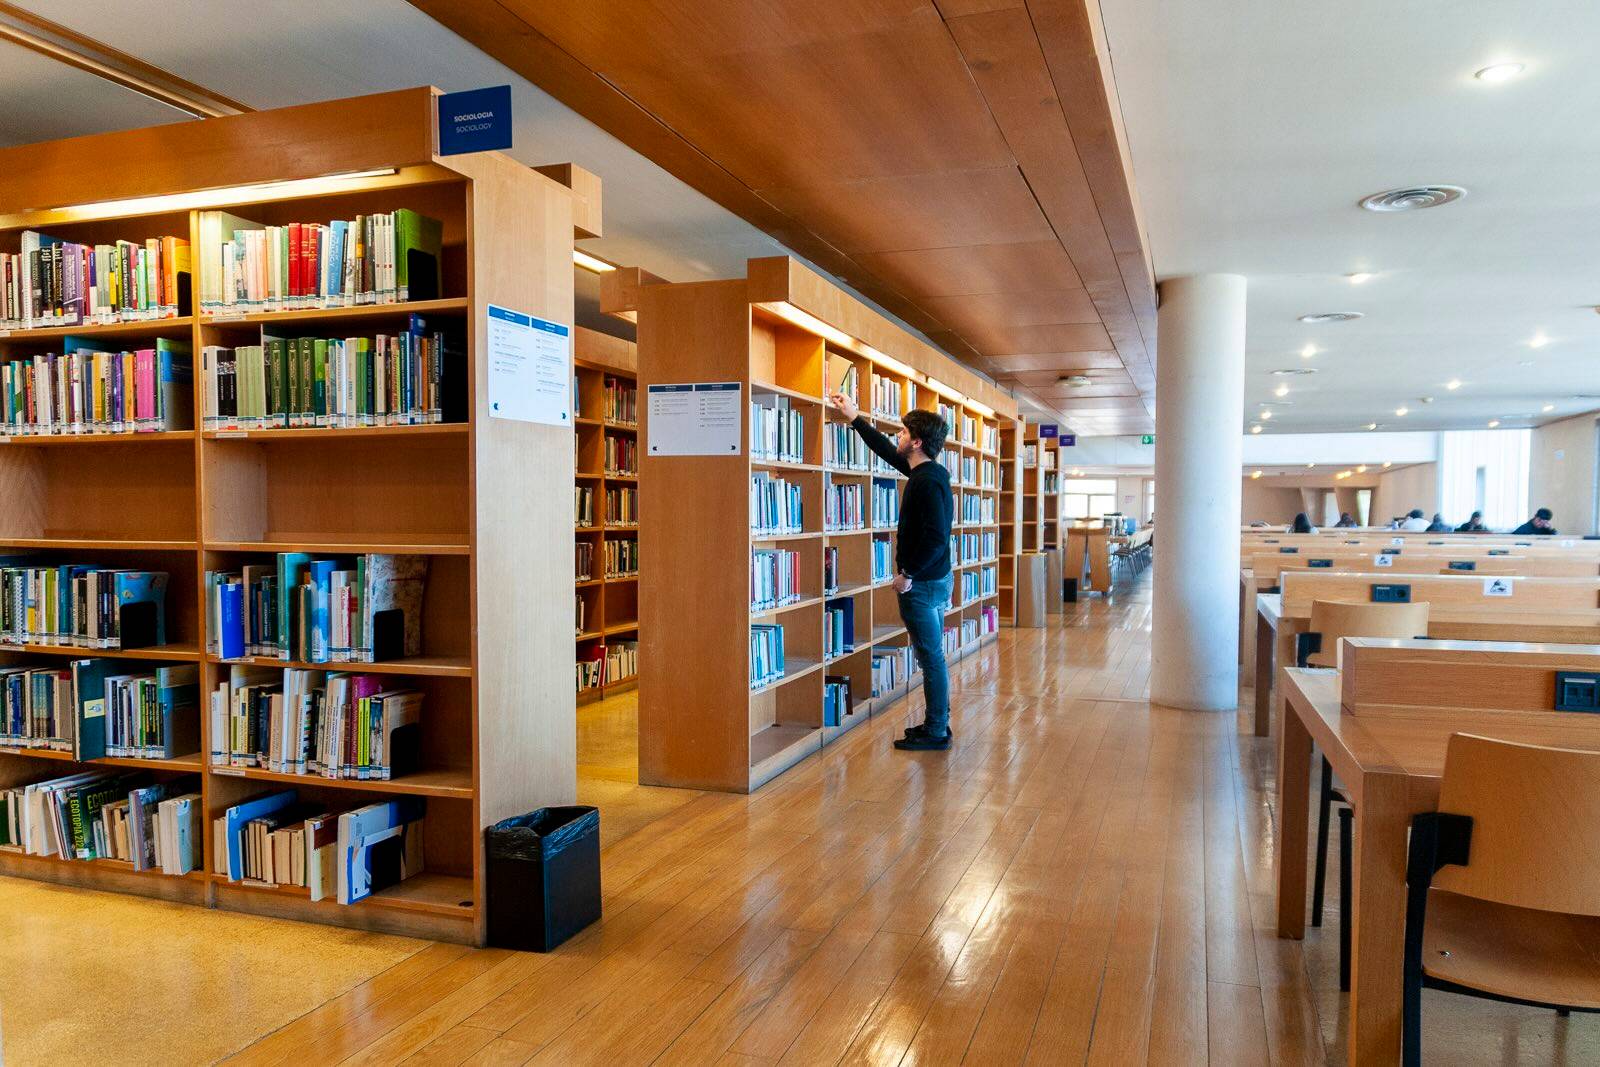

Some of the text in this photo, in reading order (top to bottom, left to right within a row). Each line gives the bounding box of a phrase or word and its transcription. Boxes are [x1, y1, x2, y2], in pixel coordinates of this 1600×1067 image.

[454, 111, 493, 122] SOCIOLOGIA
[456, 123, 492, 133] SOCIOLOGY
[71, 799, 83, 835] ECOTOPIA
